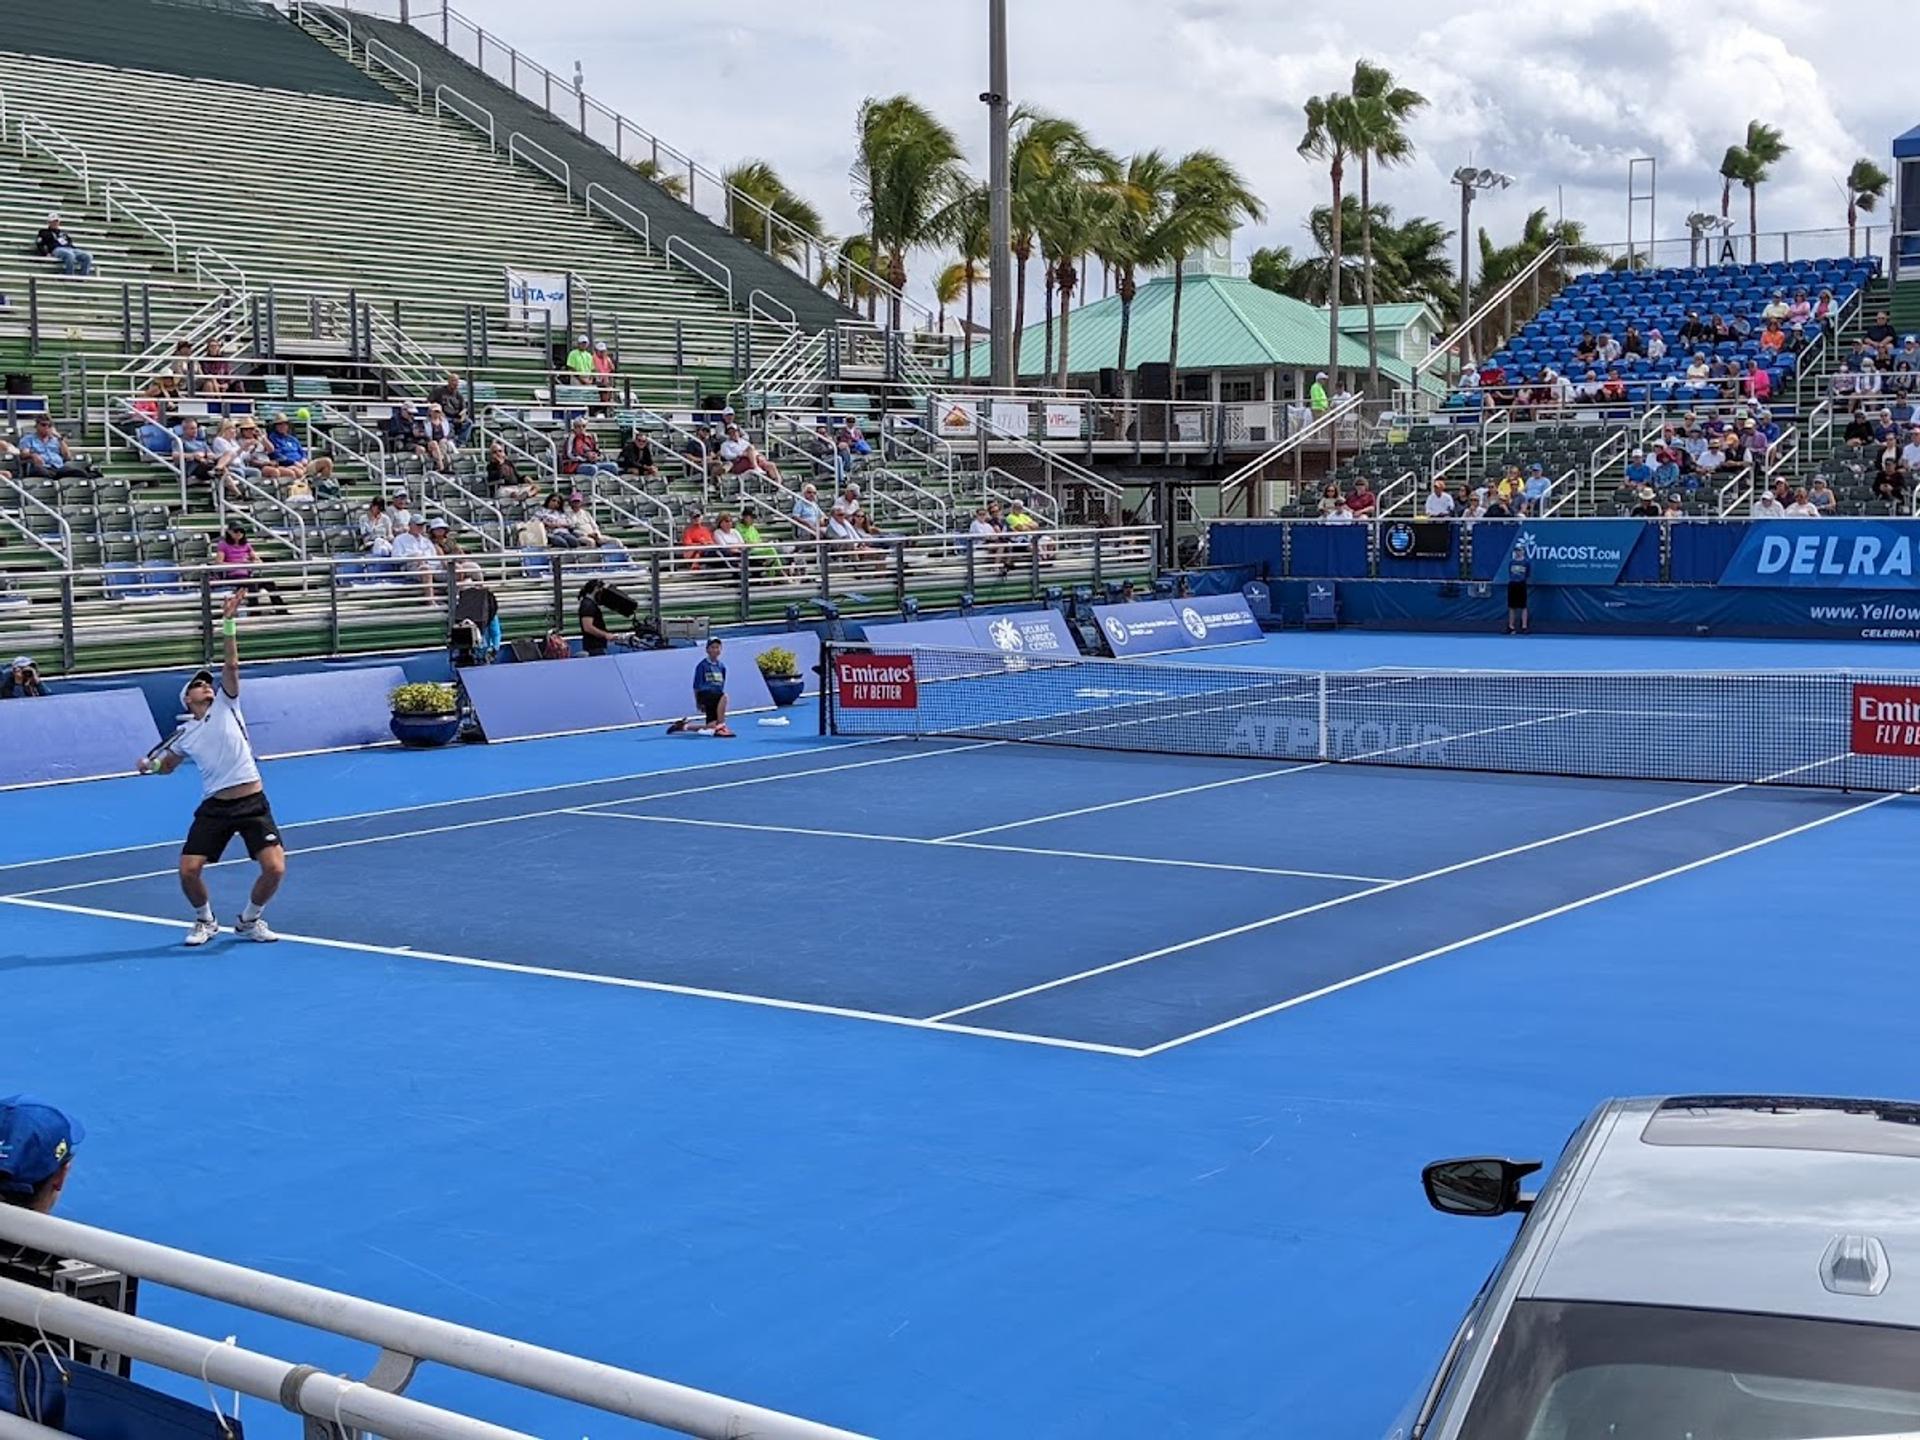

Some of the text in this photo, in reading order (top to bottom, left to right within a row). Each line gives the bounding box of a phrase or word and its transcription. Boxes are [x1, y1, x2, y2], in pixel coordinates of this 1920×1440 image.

[1720, 239, 1736, 262] A
[1525, 545, 1621, 561] VITACOST.COM
[1756, 535, 1920, 576] DELRA
[840, 663, 911, 683] Emirates
[853, 684, 902, 700] FLY BETTER
[1224, 715, 1451, 763] ATP TOUR
[1875, 724, 1901, 744] FLY
